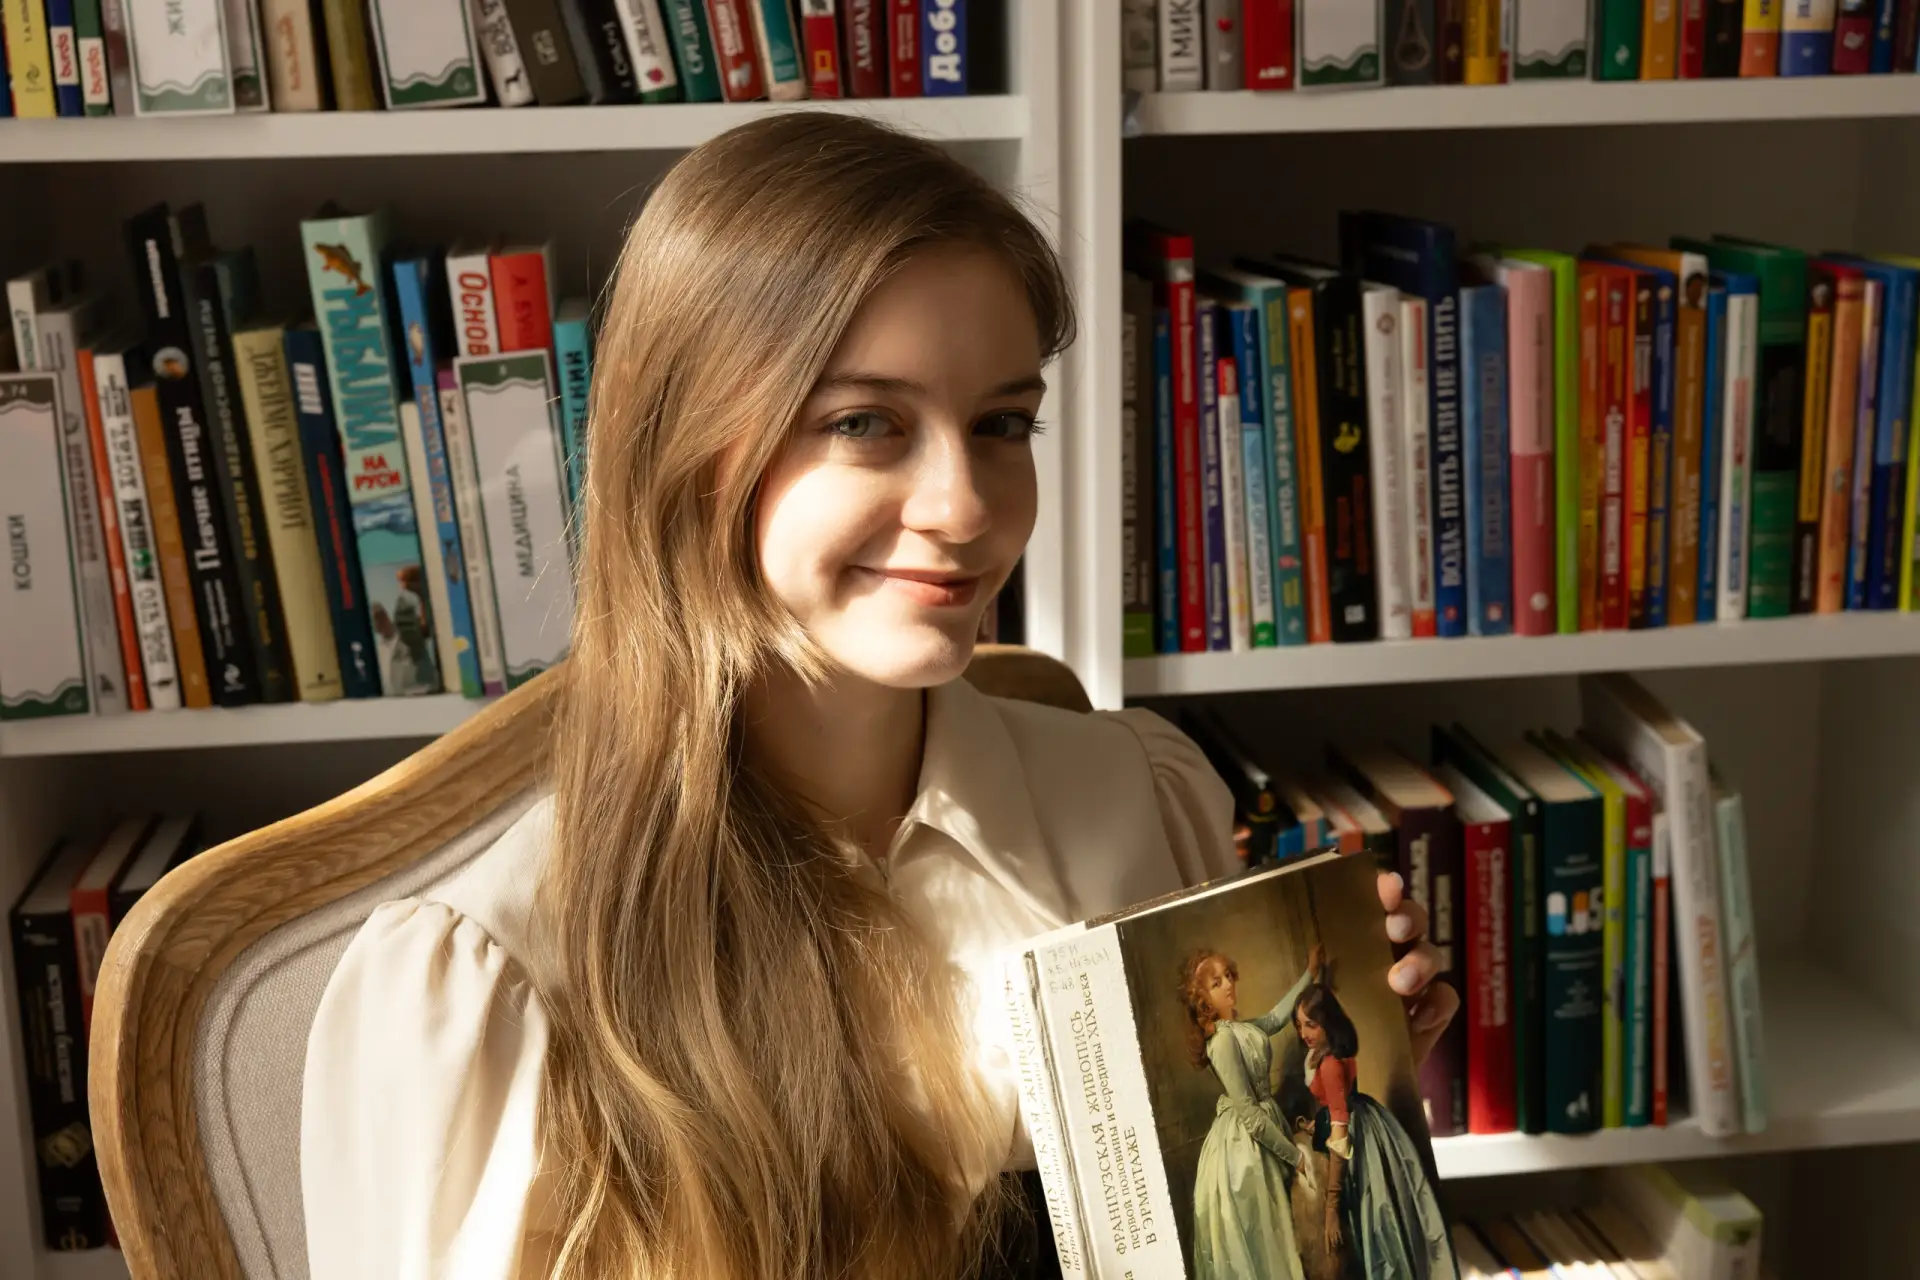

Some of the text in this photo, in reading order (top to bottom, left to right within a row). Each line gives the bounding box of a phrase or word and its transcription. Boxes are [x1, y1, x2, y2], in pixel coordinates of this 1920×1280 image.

[56, 33, 73, 79] burda
[87, 46, 104, 96] burda
[323, 288, 399, 451] РЫБАЛКА
[176, 406, 202, 481] птицы
[199, 299, 258, 560] ФЕНОМЕН МЕДОНОСНОЙ ПЧЕЛЫ
[246, 346, 308, 532] ДЖЕЙМС ХЭРРИОТ
[354, 471, 401, 490] РУСИ
[362, 453, 387, 472] НА
[1434, 296, 1462, 587] ВОДА: ПИТЬ ИЛИ НЕ ПИТЬ
[8, 514, 32, 591] КОШКИ
[191, 485, 221, 570] Певчие
[505, 464, 534, 578] МЕДИЦИНА
[1070, 1010, 1127, 1255] ФРАНЦУЗСКАЯ ЖИВОПИСЬ
[1080, 973, 1141, 1250] первой половины и середины XIX века
[1124, 1126, 1157, 1245] В ЭРМИТАЖЕ
